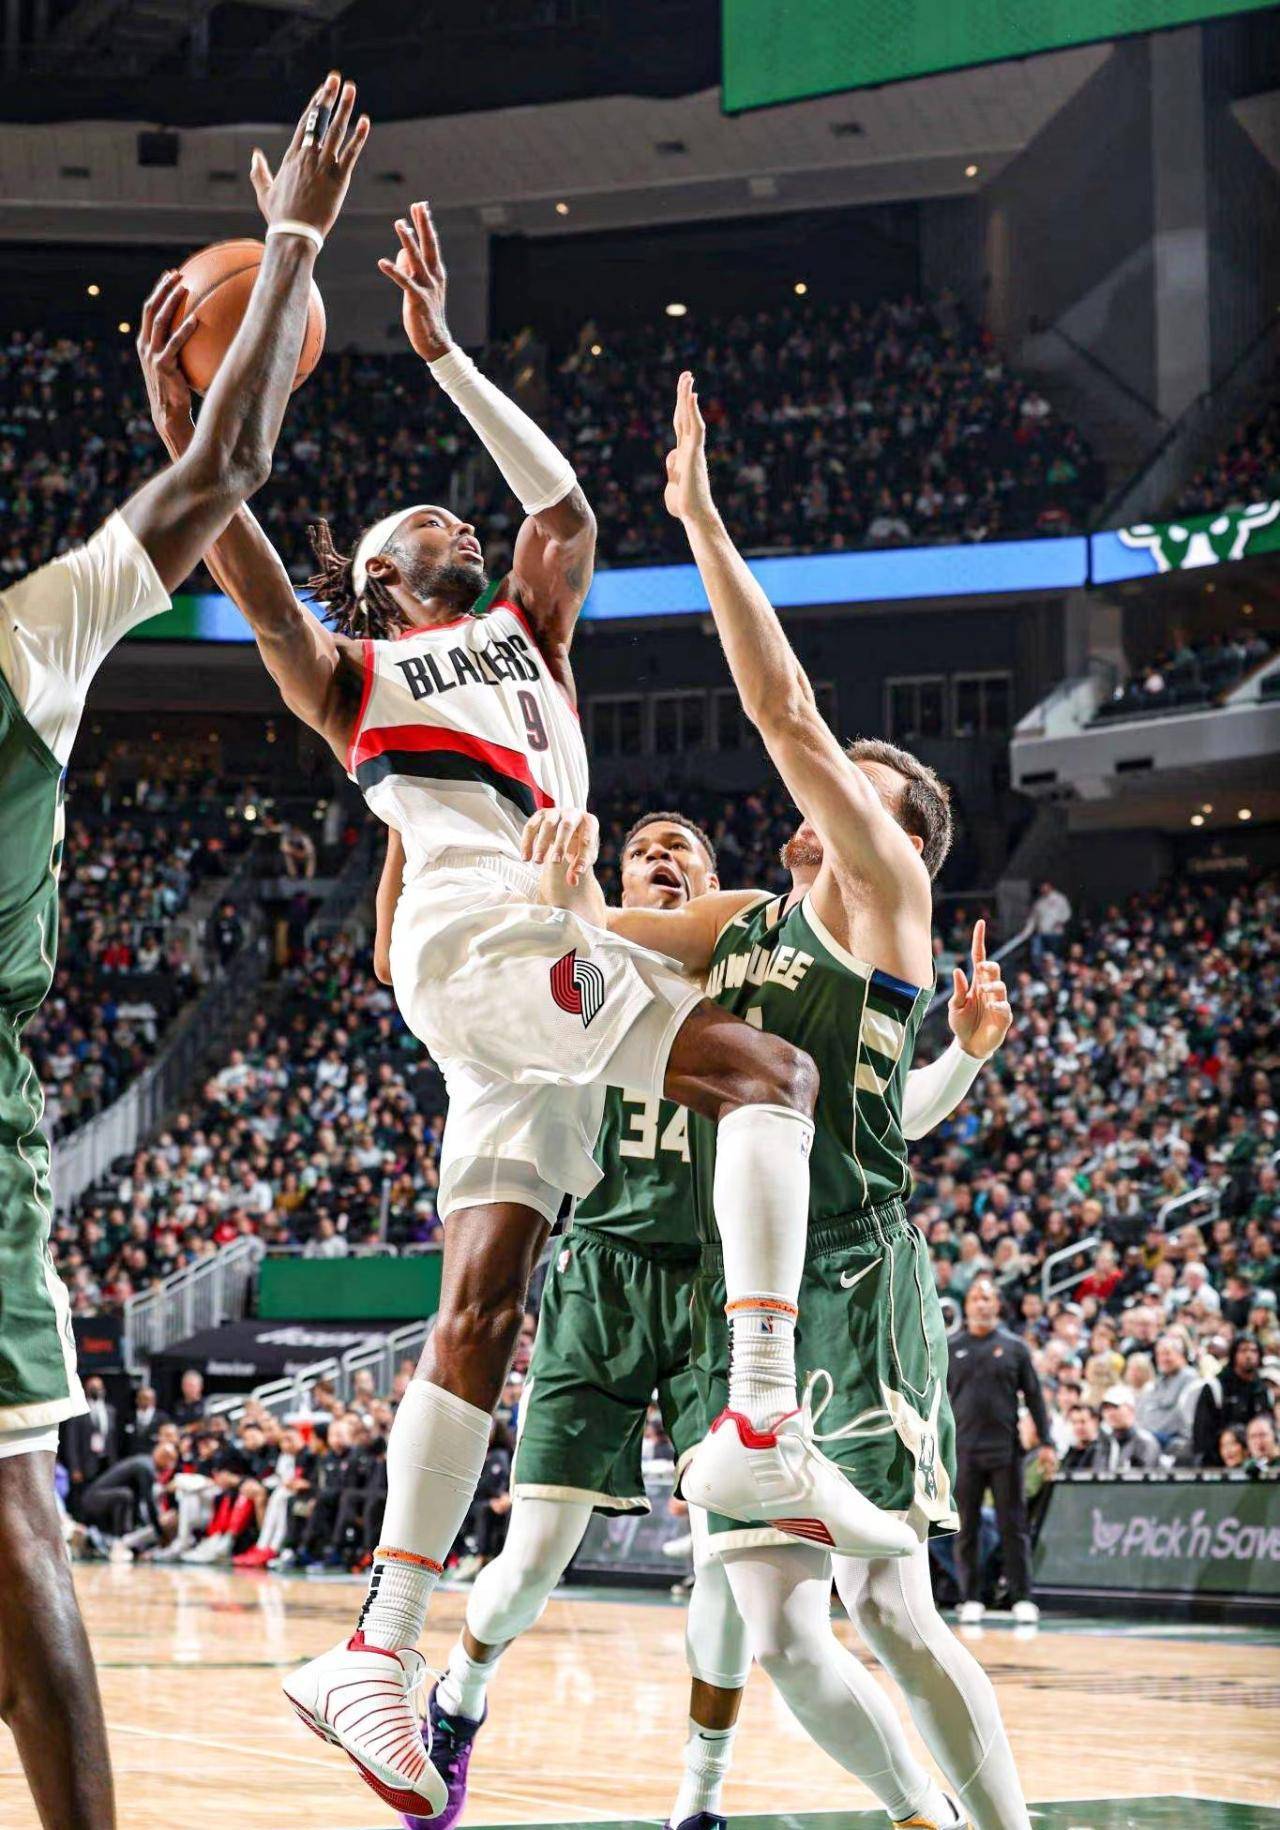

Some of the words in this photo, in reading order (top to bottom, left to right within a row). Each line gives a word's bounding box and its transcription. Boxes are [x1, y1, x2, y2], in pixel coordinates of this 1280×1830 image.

[394, 634, 540, 701] BLAZERS
[516, 689, 549, 752] 9
[618, 1087, 691, 1163] 34
